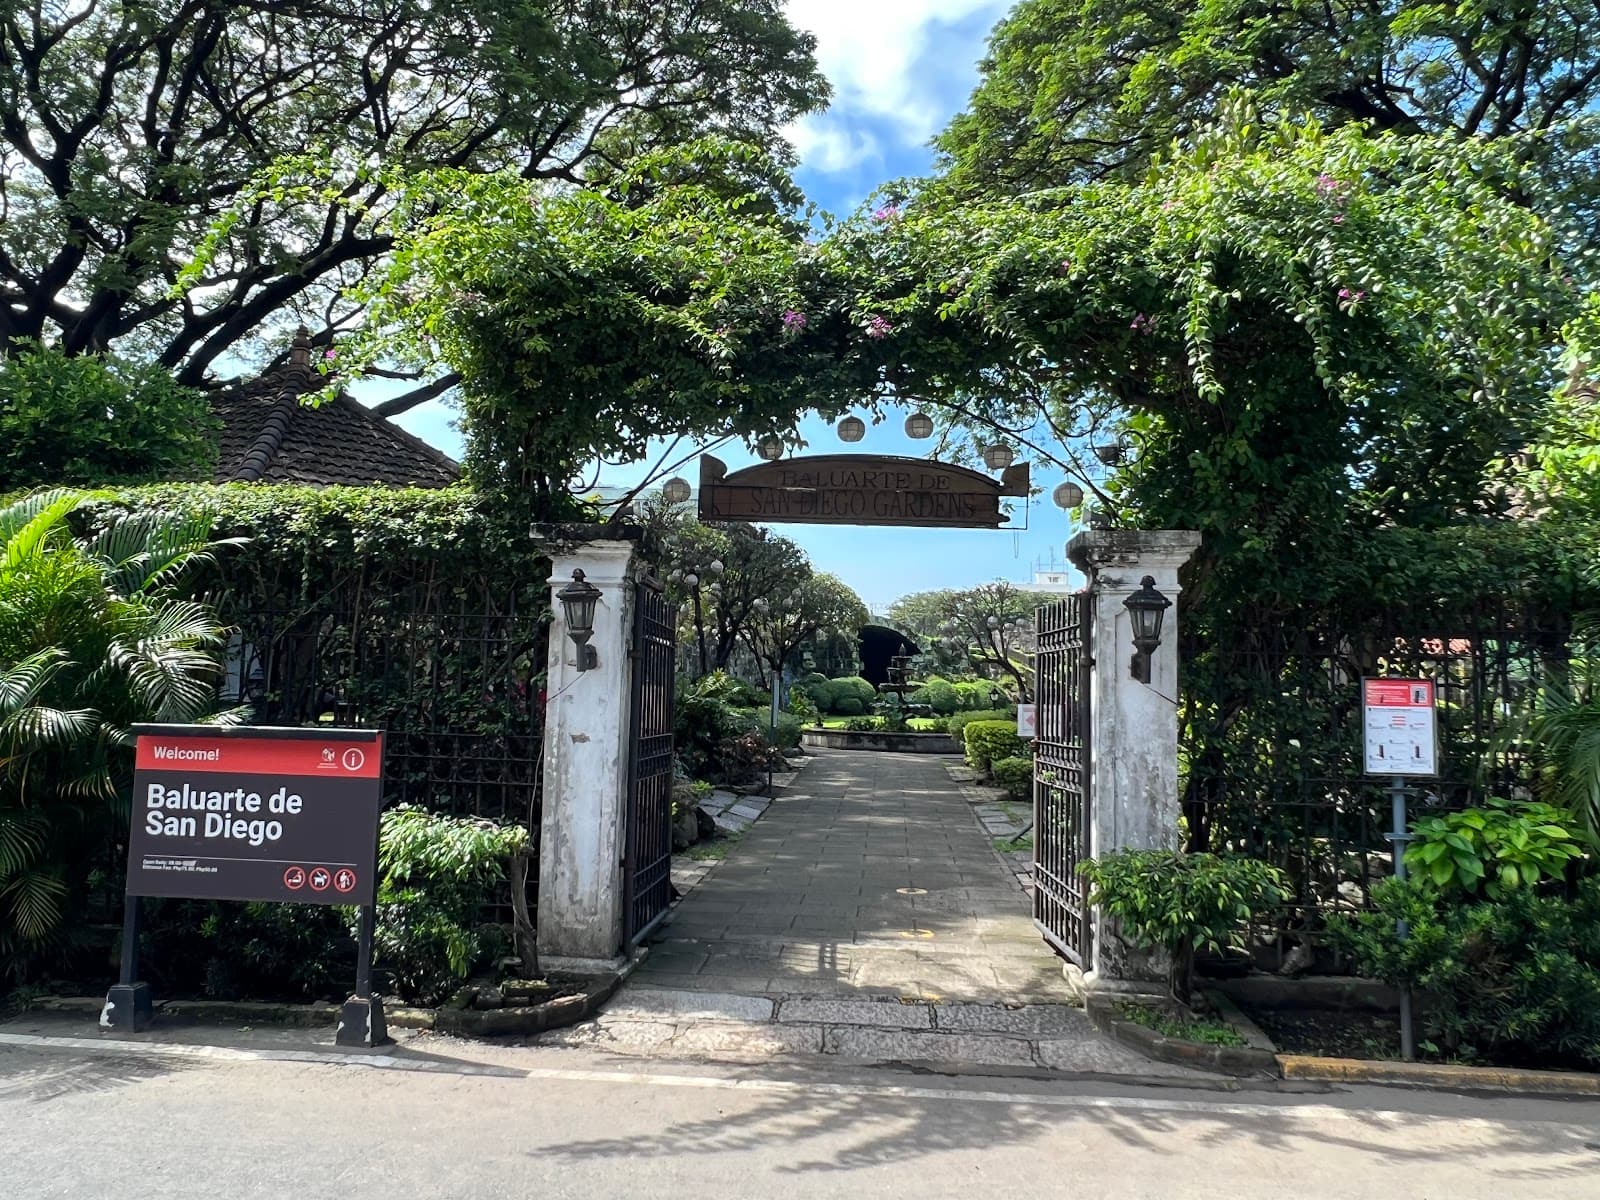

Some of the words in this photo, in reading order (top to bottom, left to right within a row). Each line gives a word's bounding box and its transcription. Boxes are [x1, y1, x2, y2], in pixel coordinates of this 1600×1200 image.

[779, 471, 911, 489] BALUARTE
[919, 474, 950, 490] DE
[750, 489, 792, 514] SAN
[799, 490, 866, 516] DIEGO
[873, 491, 977, 518] GARDENS
[153, 746, 220, 761] Welcome!
[147, 783, 262, 813] Baluarte
[268, 787, 303, 814] de
[145, 811, 196, 837] San
[204, 812, 283, 846] Diego
